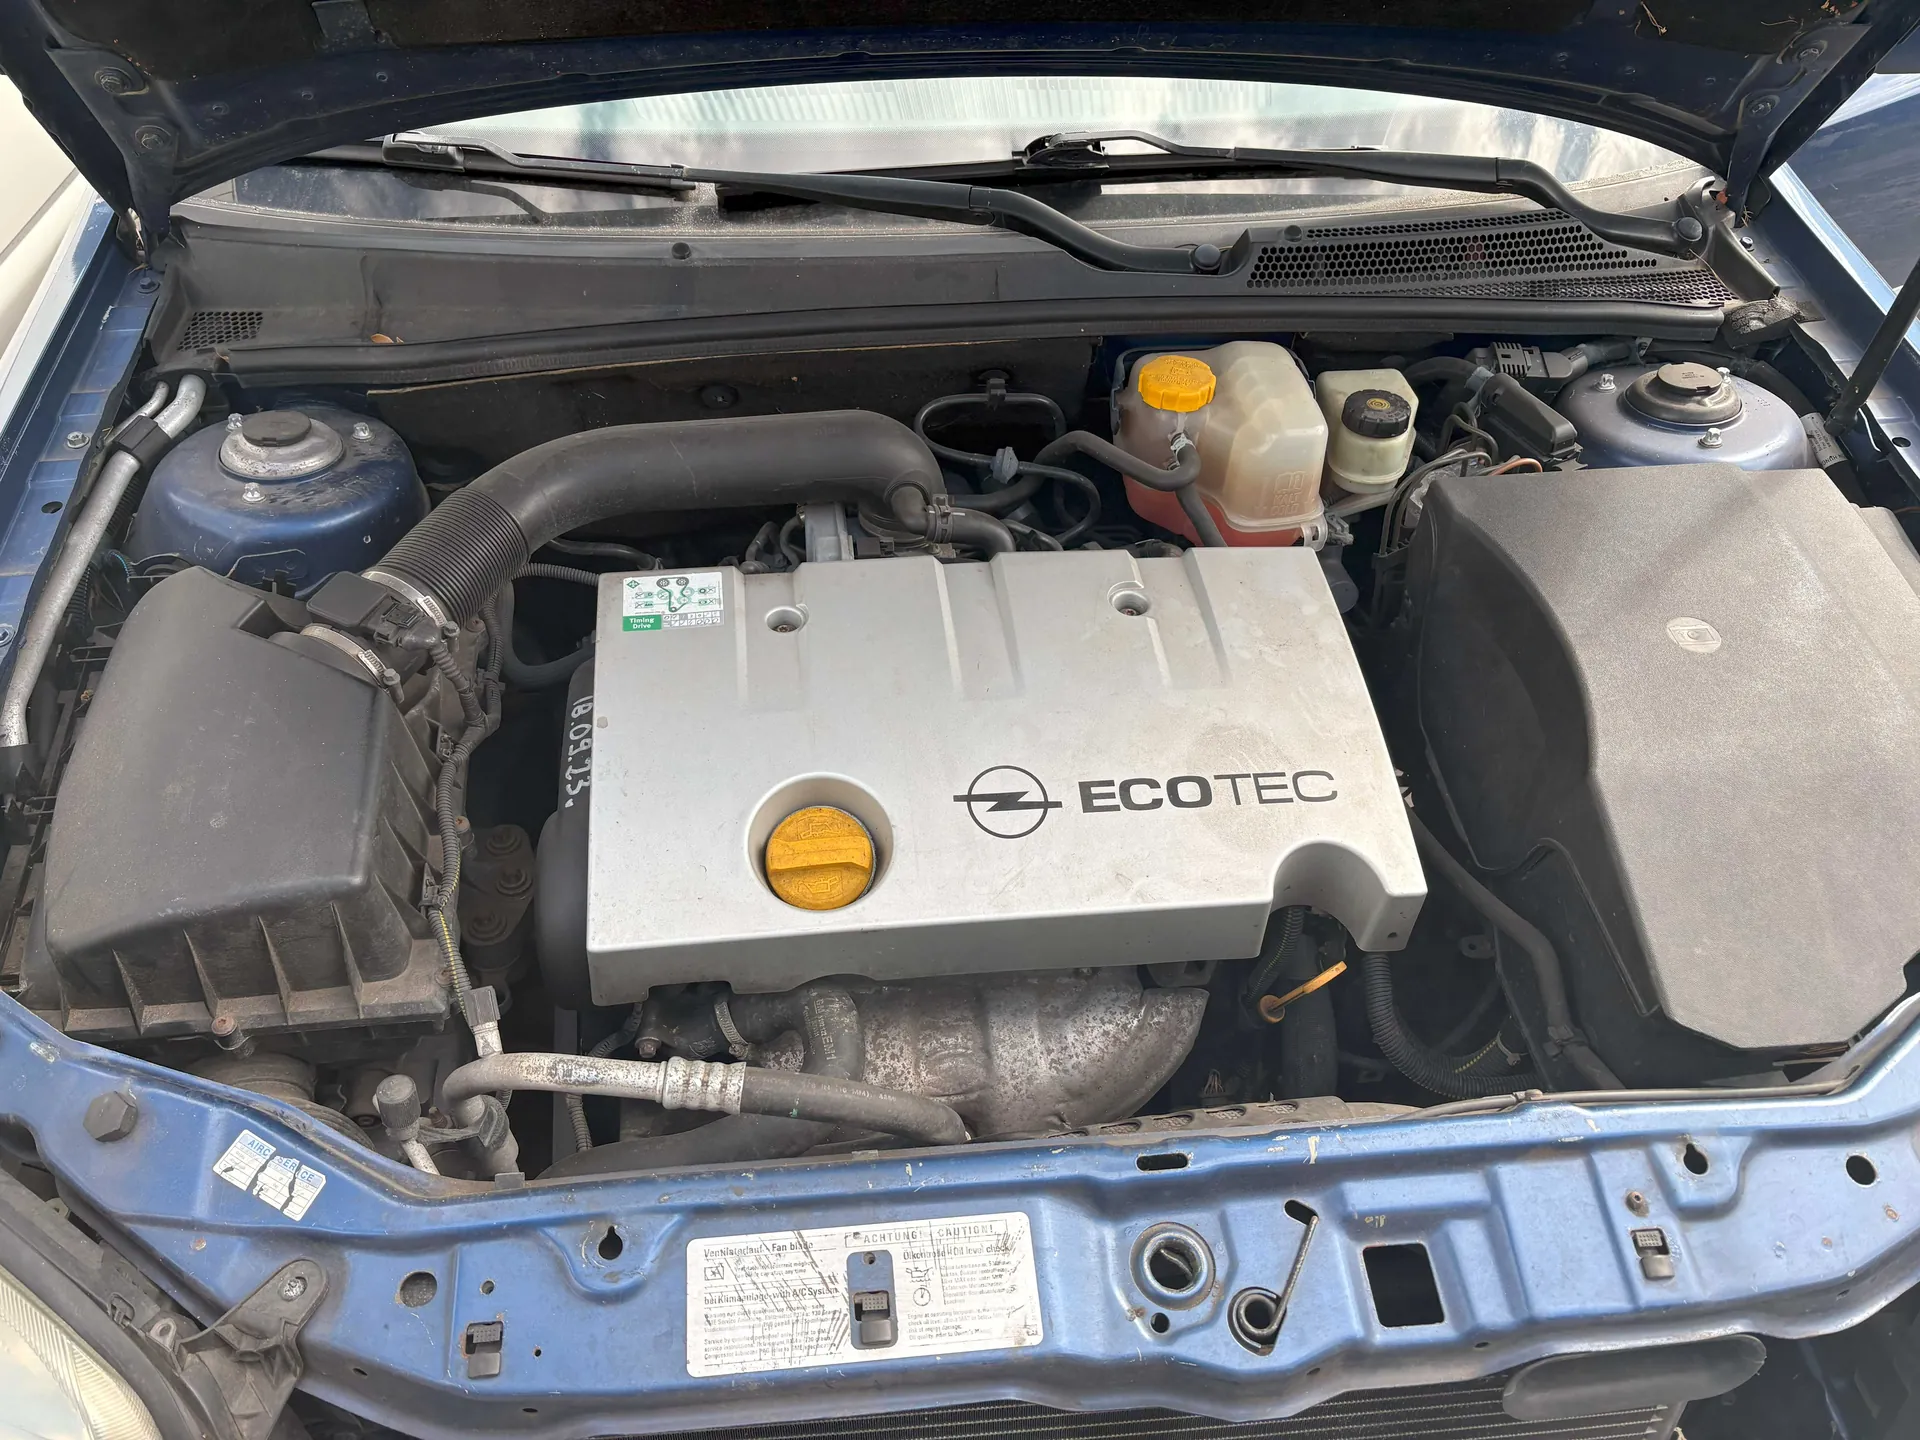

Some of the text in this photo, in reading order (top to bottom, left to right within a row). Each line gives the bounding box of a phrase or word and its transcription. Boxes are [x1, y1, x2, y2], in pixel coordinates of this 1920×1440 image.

[1077, 770, 1338, 813] ECOTEC
[247, 1139, 271, 1157] AIRC
[863, 1224, 993, 1244] ACHTUNG! CAUTION!
[772, 1242, 787, 1252] Fan
